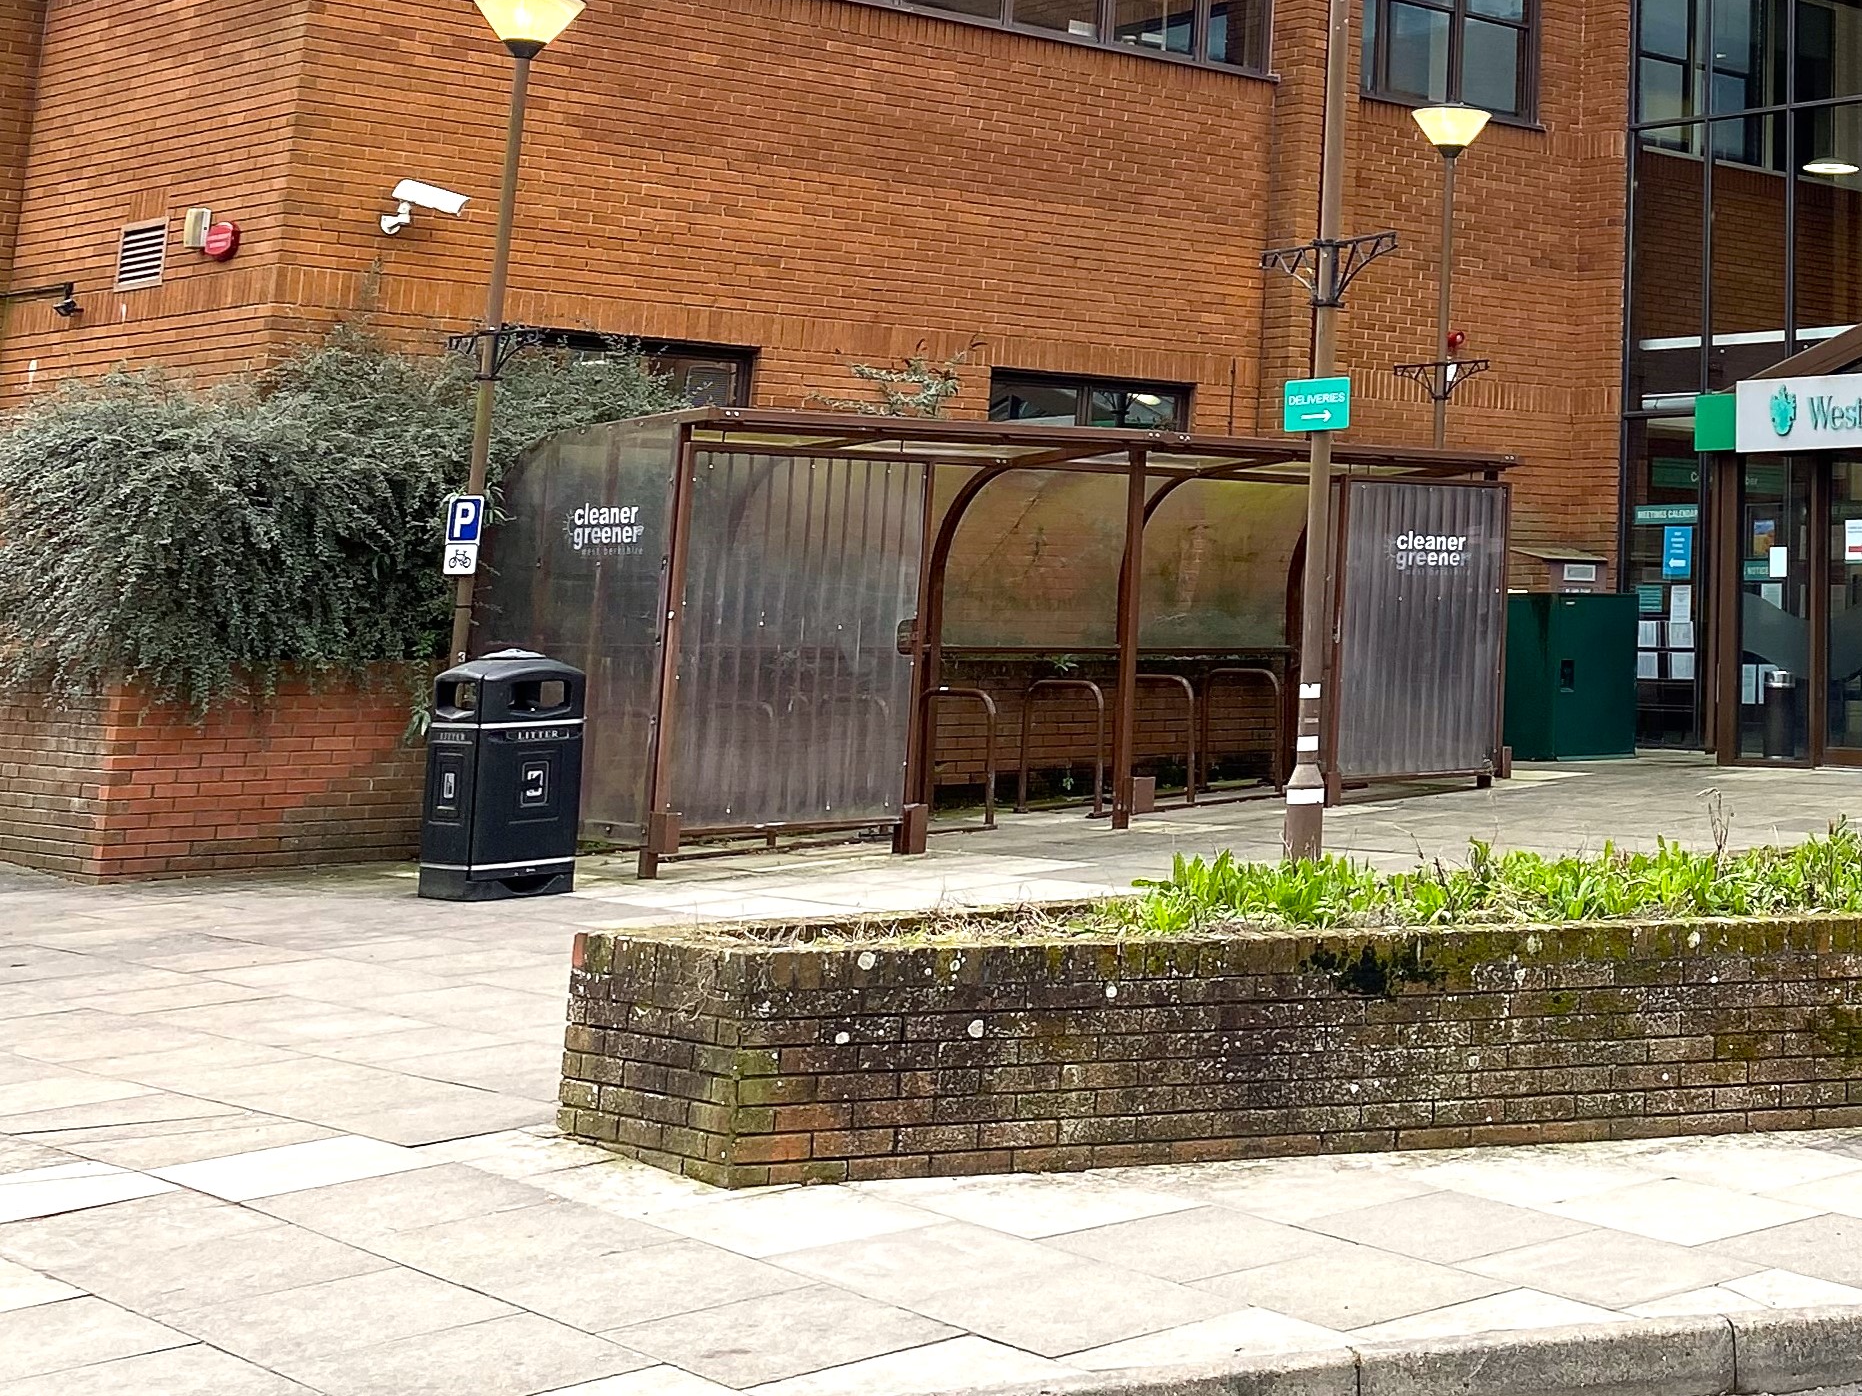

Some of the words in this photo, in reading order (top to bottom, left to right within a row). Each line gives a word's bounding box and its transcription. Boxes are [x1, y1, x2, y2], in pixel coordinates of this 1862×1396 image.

[1288, 392, 1346, 406] DELIVERIES
[453, 501, 477, 538] P
[574, 502, 639, 525] cleaner
[573, 525, 640, 550] greener
[1396, 530, 1467, 551] cleaner
[1395, 551, 1468, 570] greener
[517, 730, 559, 740] LITTER
